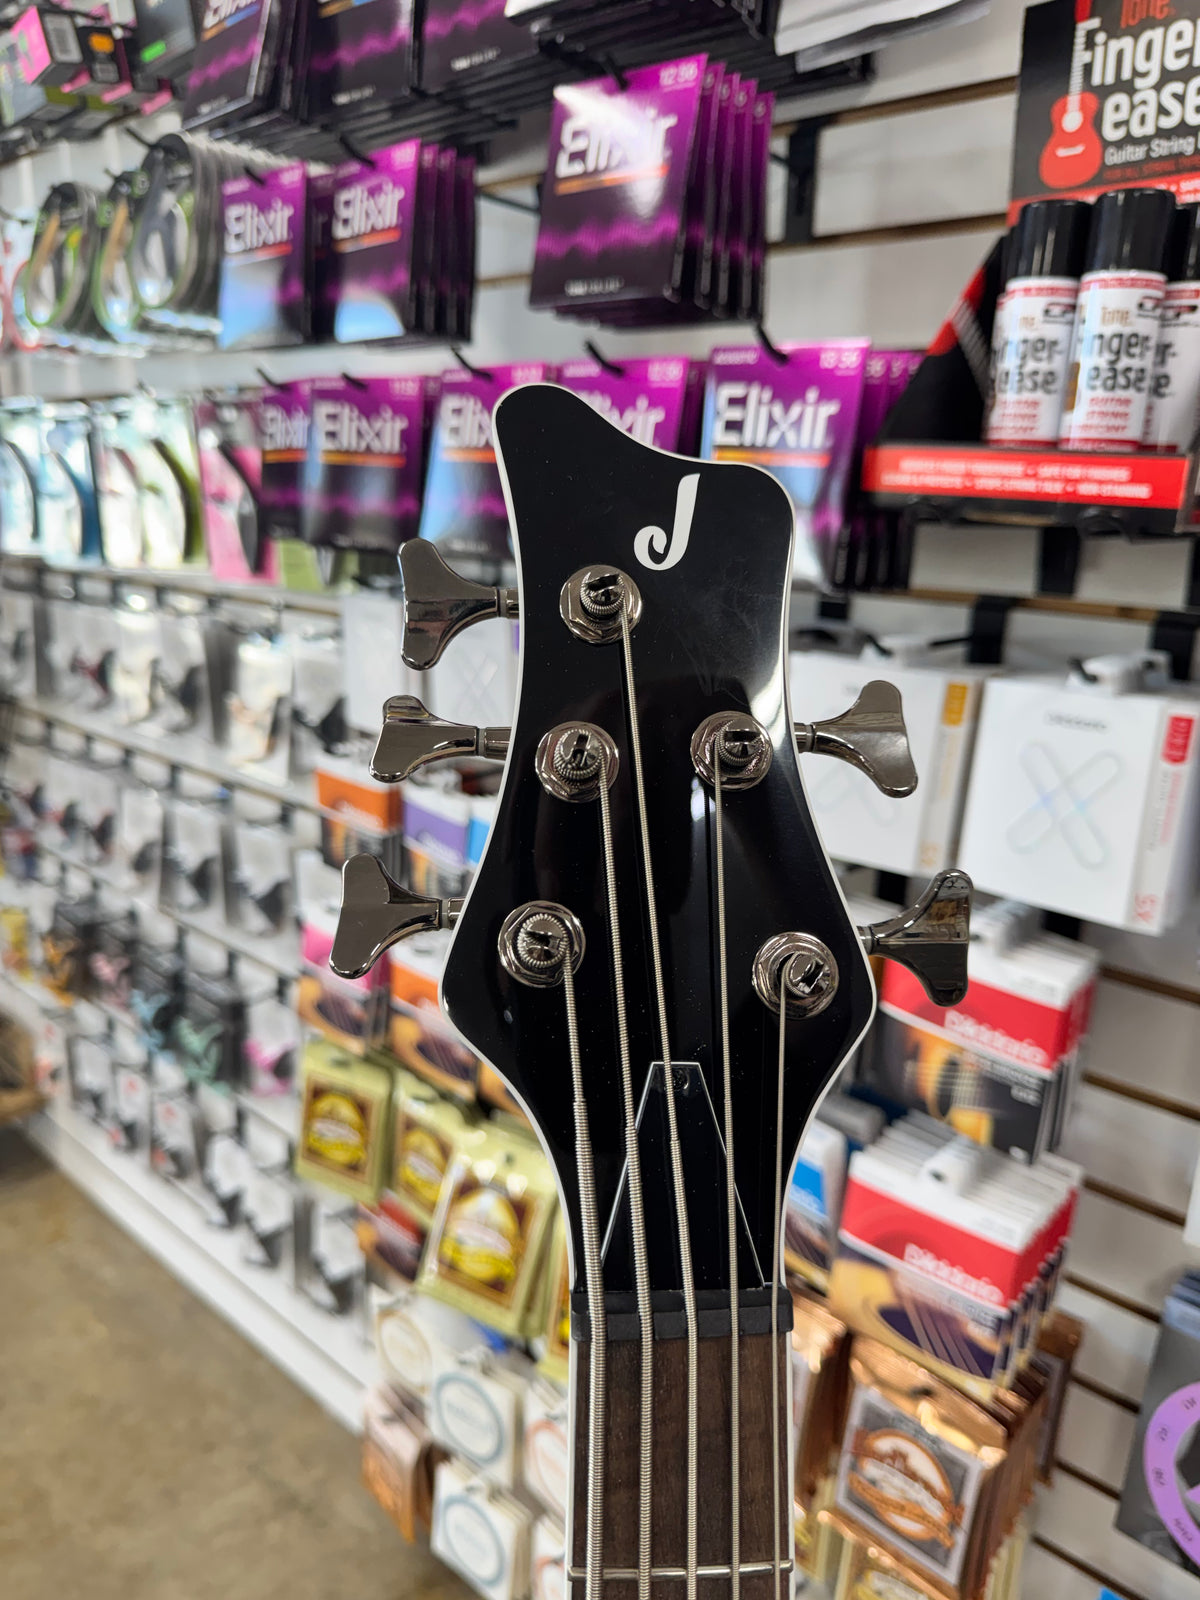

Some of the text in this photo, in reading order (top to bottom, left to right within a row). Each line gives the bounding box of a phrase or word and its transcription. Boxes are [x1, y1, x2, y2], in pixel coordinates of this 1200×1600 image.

[1104, 135, 1195, 166] Guitar String
[224, 198, 294, 254] Elixir
[332, 178, 405, 241] Elixir
[311, 401, 408, 453] Elixir
[714, 382, 841, 448] Elixir
[633, 473, 701, 571] J
